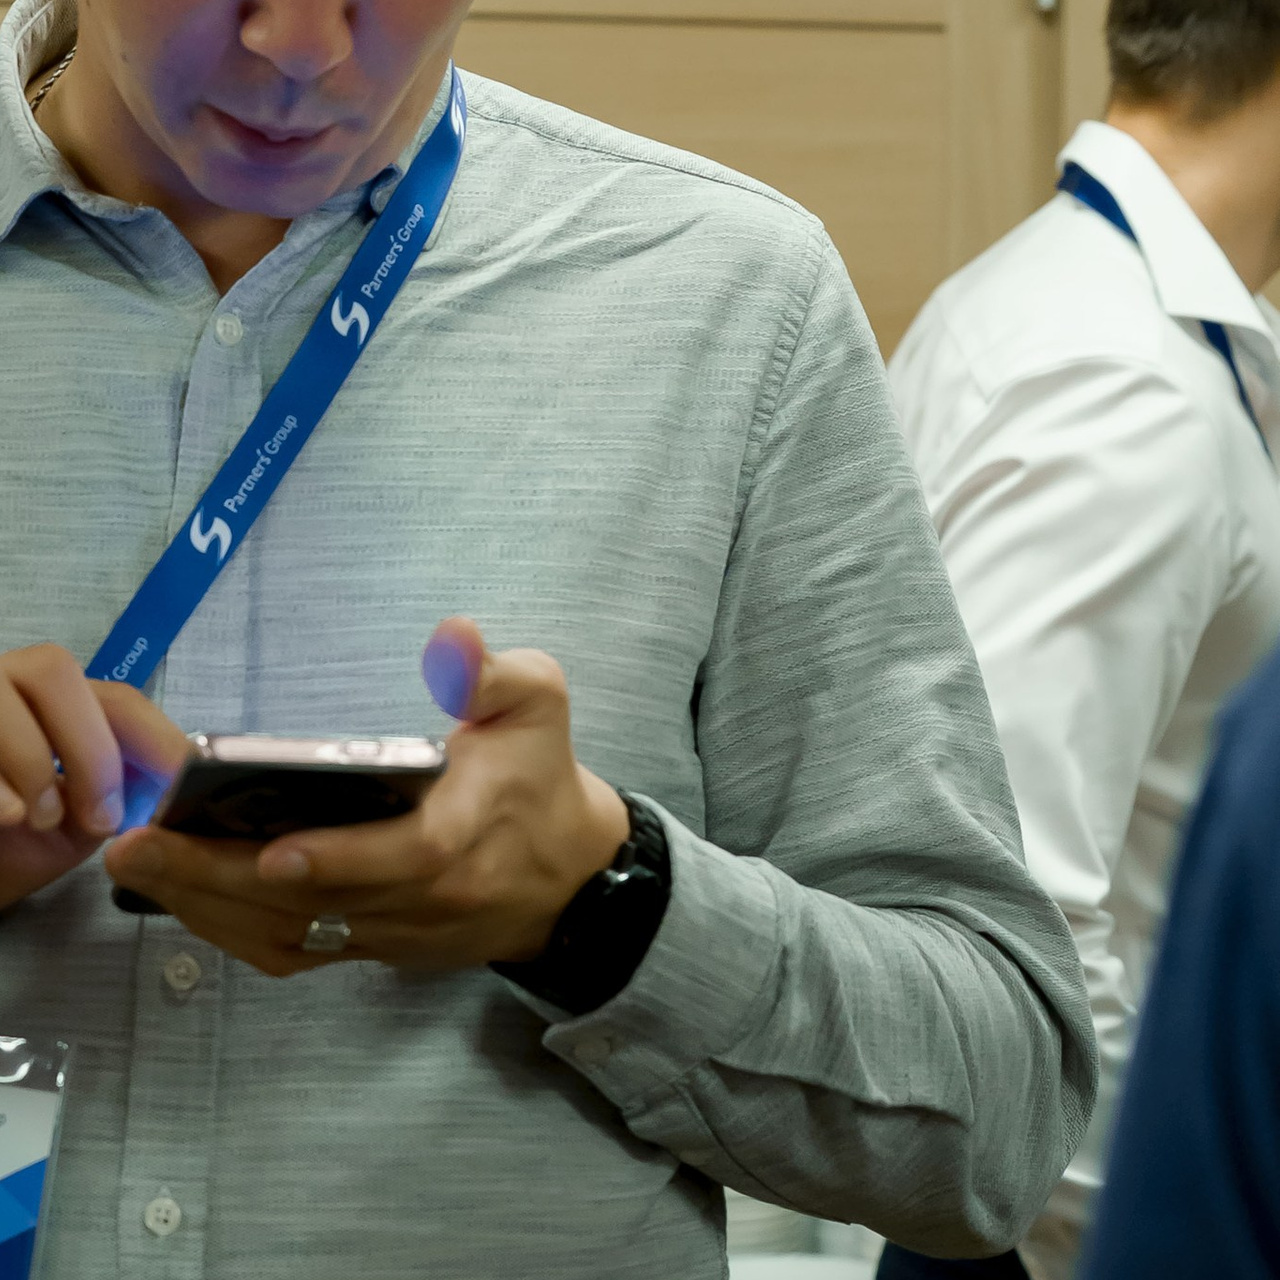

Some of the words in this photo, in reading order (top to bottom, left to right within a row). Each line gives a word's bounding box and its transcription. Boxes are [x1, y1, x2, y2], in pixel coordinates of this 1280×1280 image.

[397, 203, 426, 243] Group
[264, 414, 299, 455] Group
[112, 637, 149, 681] Group
